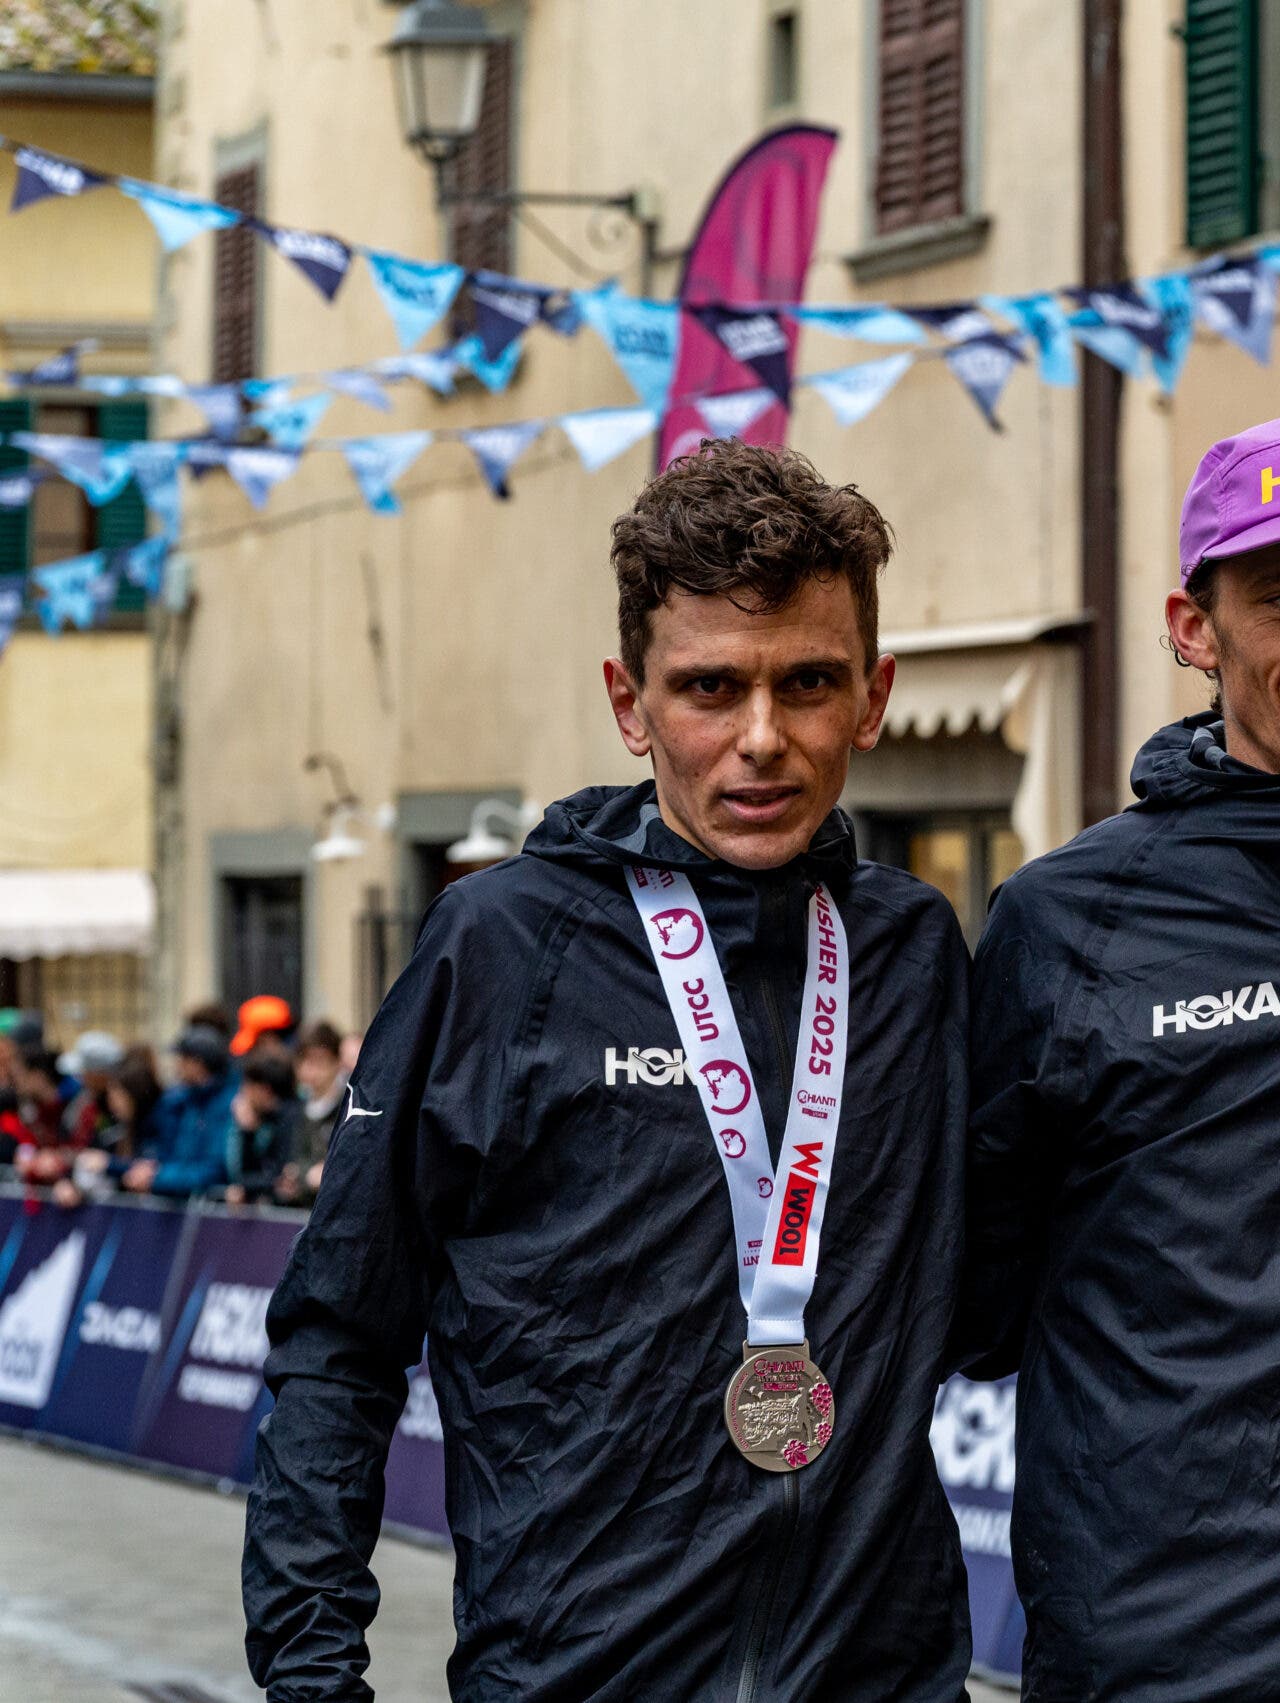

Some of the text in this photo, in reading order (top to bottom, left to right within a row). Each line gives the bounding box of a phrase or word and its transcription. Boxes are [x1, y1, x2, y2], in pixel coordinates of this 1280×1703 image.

[682, 977, 720, 1042] UTCC
[808, 993, 837, 1076] 2025
[797, 1089, 837, 1107] CHIANTI
